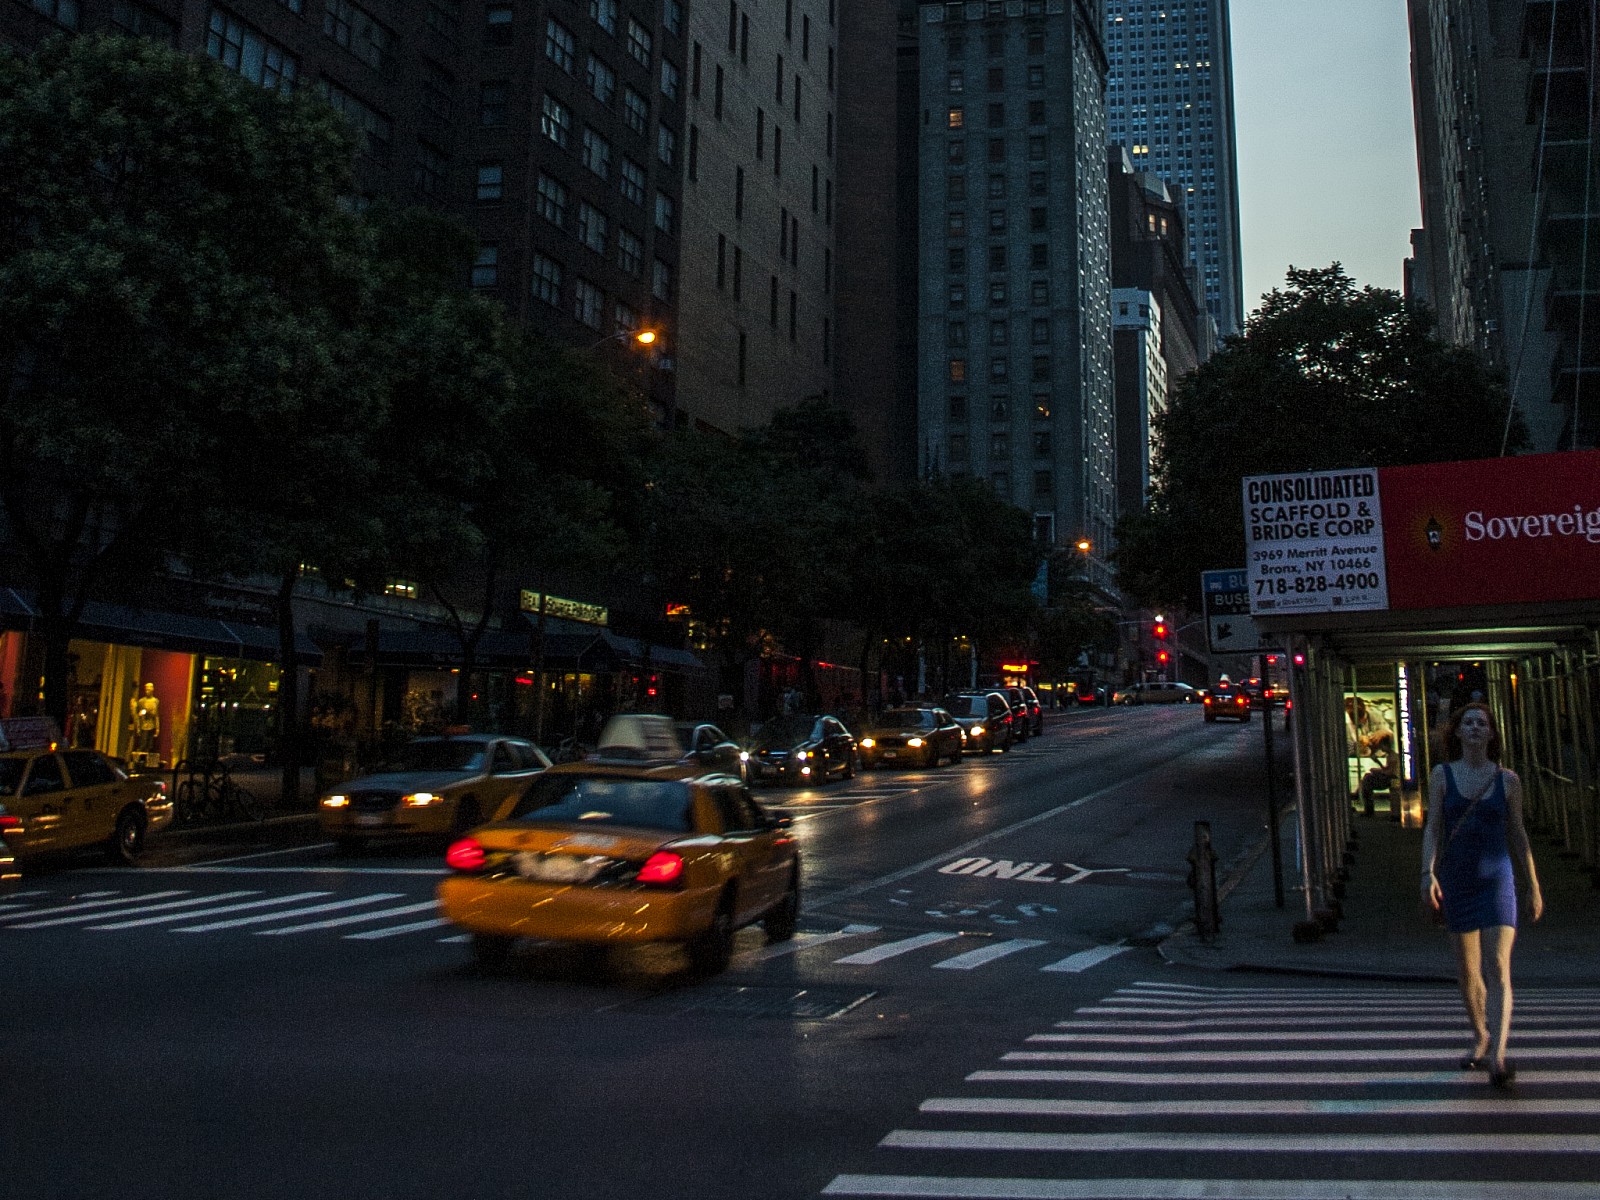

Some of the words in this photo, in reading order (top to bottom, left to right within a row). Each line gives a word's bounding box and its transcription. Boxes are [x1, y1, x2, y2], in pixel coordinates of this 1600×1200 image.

[1248, 474, 1375, 504] CONSOLIDATED
[1250, 502, 1350, 524] SCAFFOLD
[1357, 501, 1371, 517] &
[1464, 503, 1600, 544] Sovereig
[1252, 522, 1319, 541] BRIDGE
[1324, 519, 1374, 537] CORP
[1253, 549, 1283, 562] 3969
[1287, 546, 1327, 559] Merritt
[1331, 545, 1377, 556] Avenue
[1261, 564, 1301, 576] Bronx,
[1305, 560, 1326, 572] NY
[1331, 557, 1371, 570] 10466
[1254, 572, 1379, 595] 718-828-4900
[937, 856, 1132, 884] ONLY
